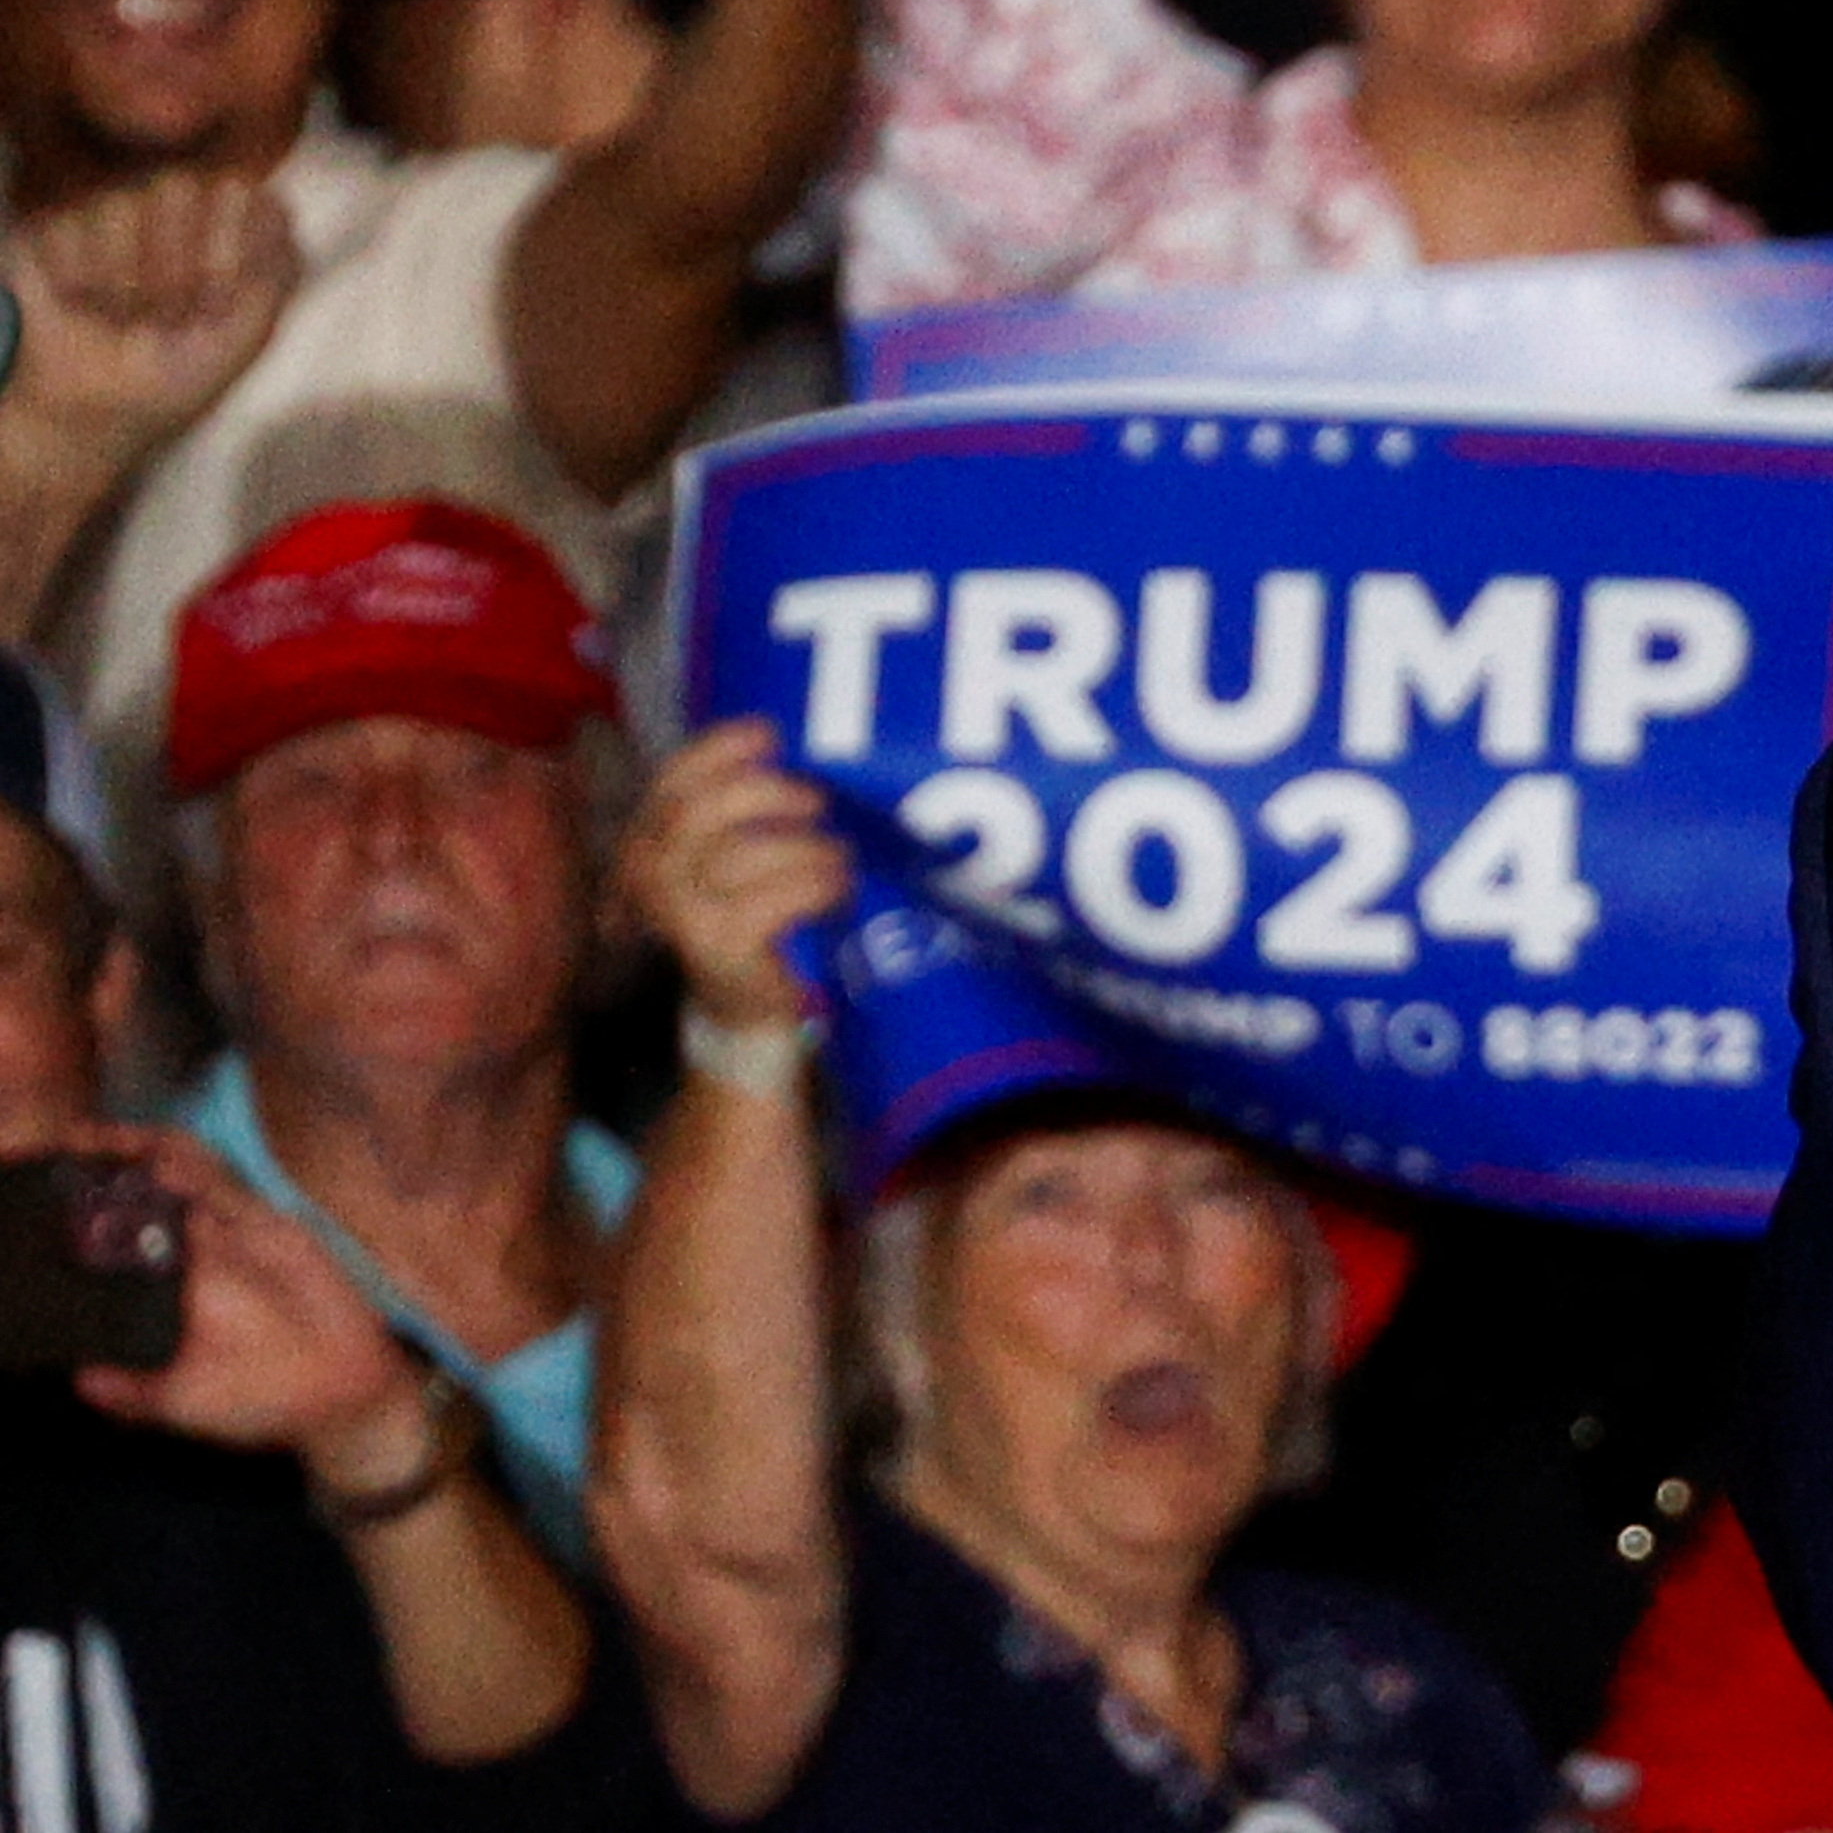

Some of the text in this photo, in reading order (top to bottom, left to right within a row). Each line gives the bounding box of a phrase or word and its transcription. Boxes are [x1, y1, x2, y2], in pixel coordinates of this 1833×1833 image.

[768, 568, 1753, 766] TRUMP
[895, 766, 1600, 974] 2024
[1333, 996, 1466, 1078] TO
[1480, 1000, 1763, 1084] 88022
